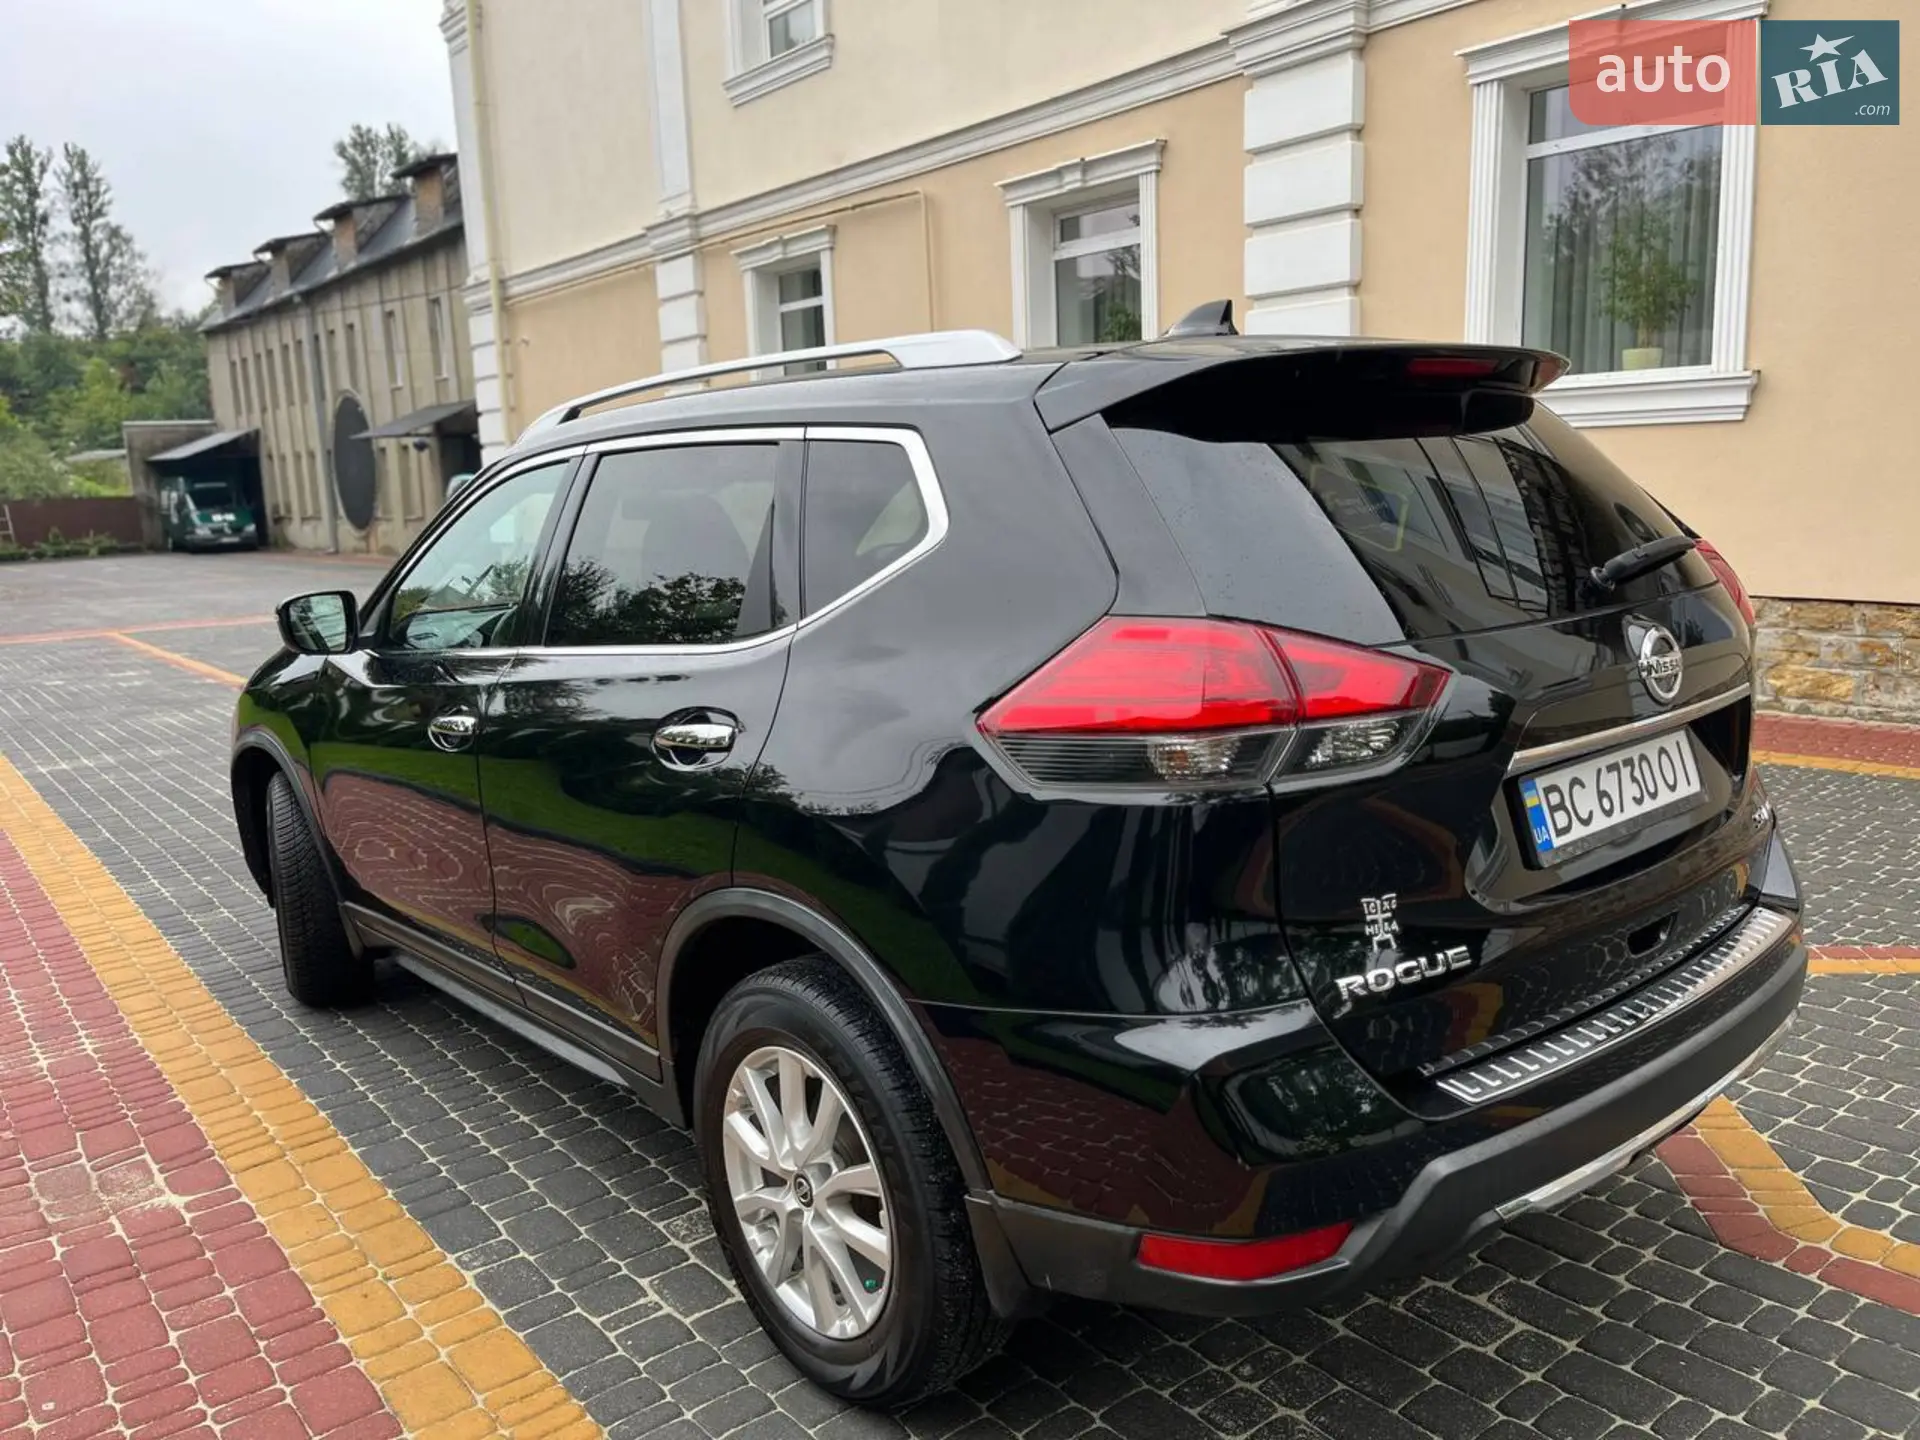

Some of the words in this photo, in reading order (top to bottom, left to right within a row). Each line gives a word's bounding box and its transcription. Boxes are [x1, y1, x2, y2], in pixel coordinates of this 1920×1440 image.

[1541, 776, 1594, 838] BC
[1595, 752, 1660, 818] 6730
[1533, 827, 1550, 844] UA
[1333, 945, 1473, 1018] ROGUE
